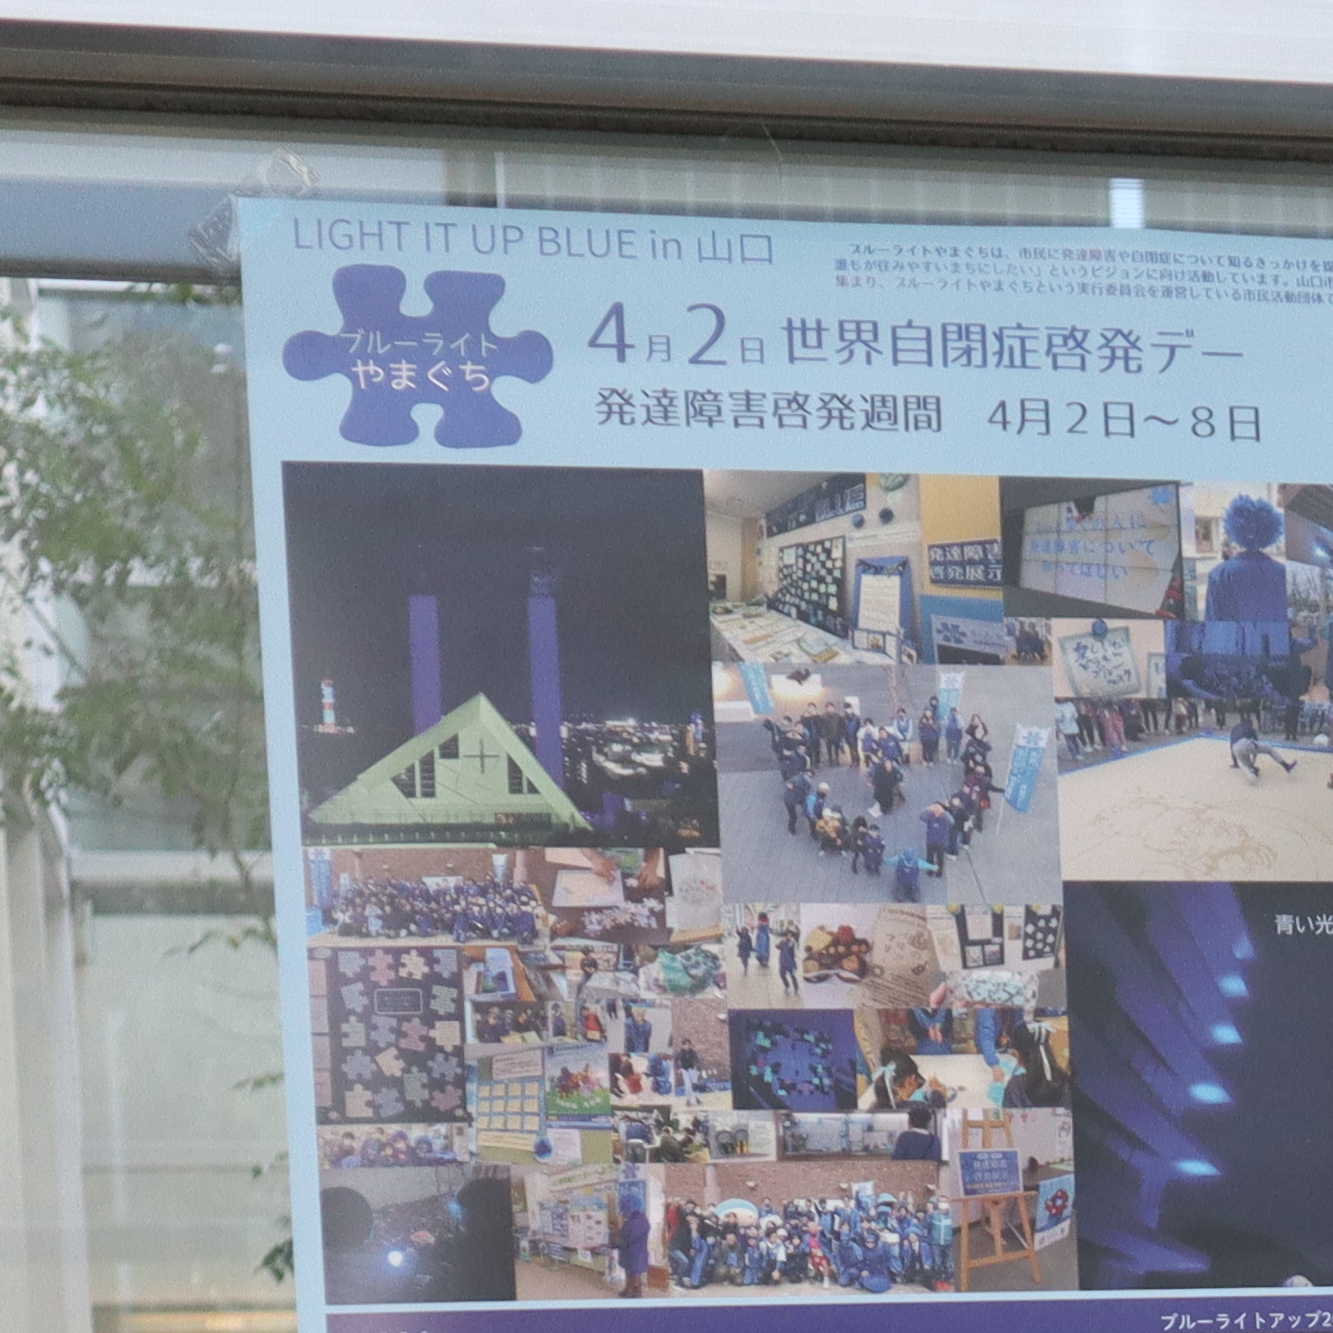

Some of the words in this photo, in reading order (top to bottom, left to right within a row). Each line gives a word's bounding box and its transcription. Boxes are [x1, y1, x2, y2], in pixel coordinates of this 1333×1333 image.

[293, 217, 411, 252] LIGHT
[425, 221, 457, 254] IT
[472, 222, 525, 257] UP
[538, 227, 638, 261] BLUE
[650, 229, 684, 262] in
[698, 231, 775, 266] 山口
[339, 329, 500, 357] ブルーライト
[586, 300, 767, 368] 4月2日
[782, 315, 1246, 377] 世界自閉症啓発デー
[350, 359, 492, 394] やまぐち
[594, 386, 944, 435] 発達障害啓発週間
